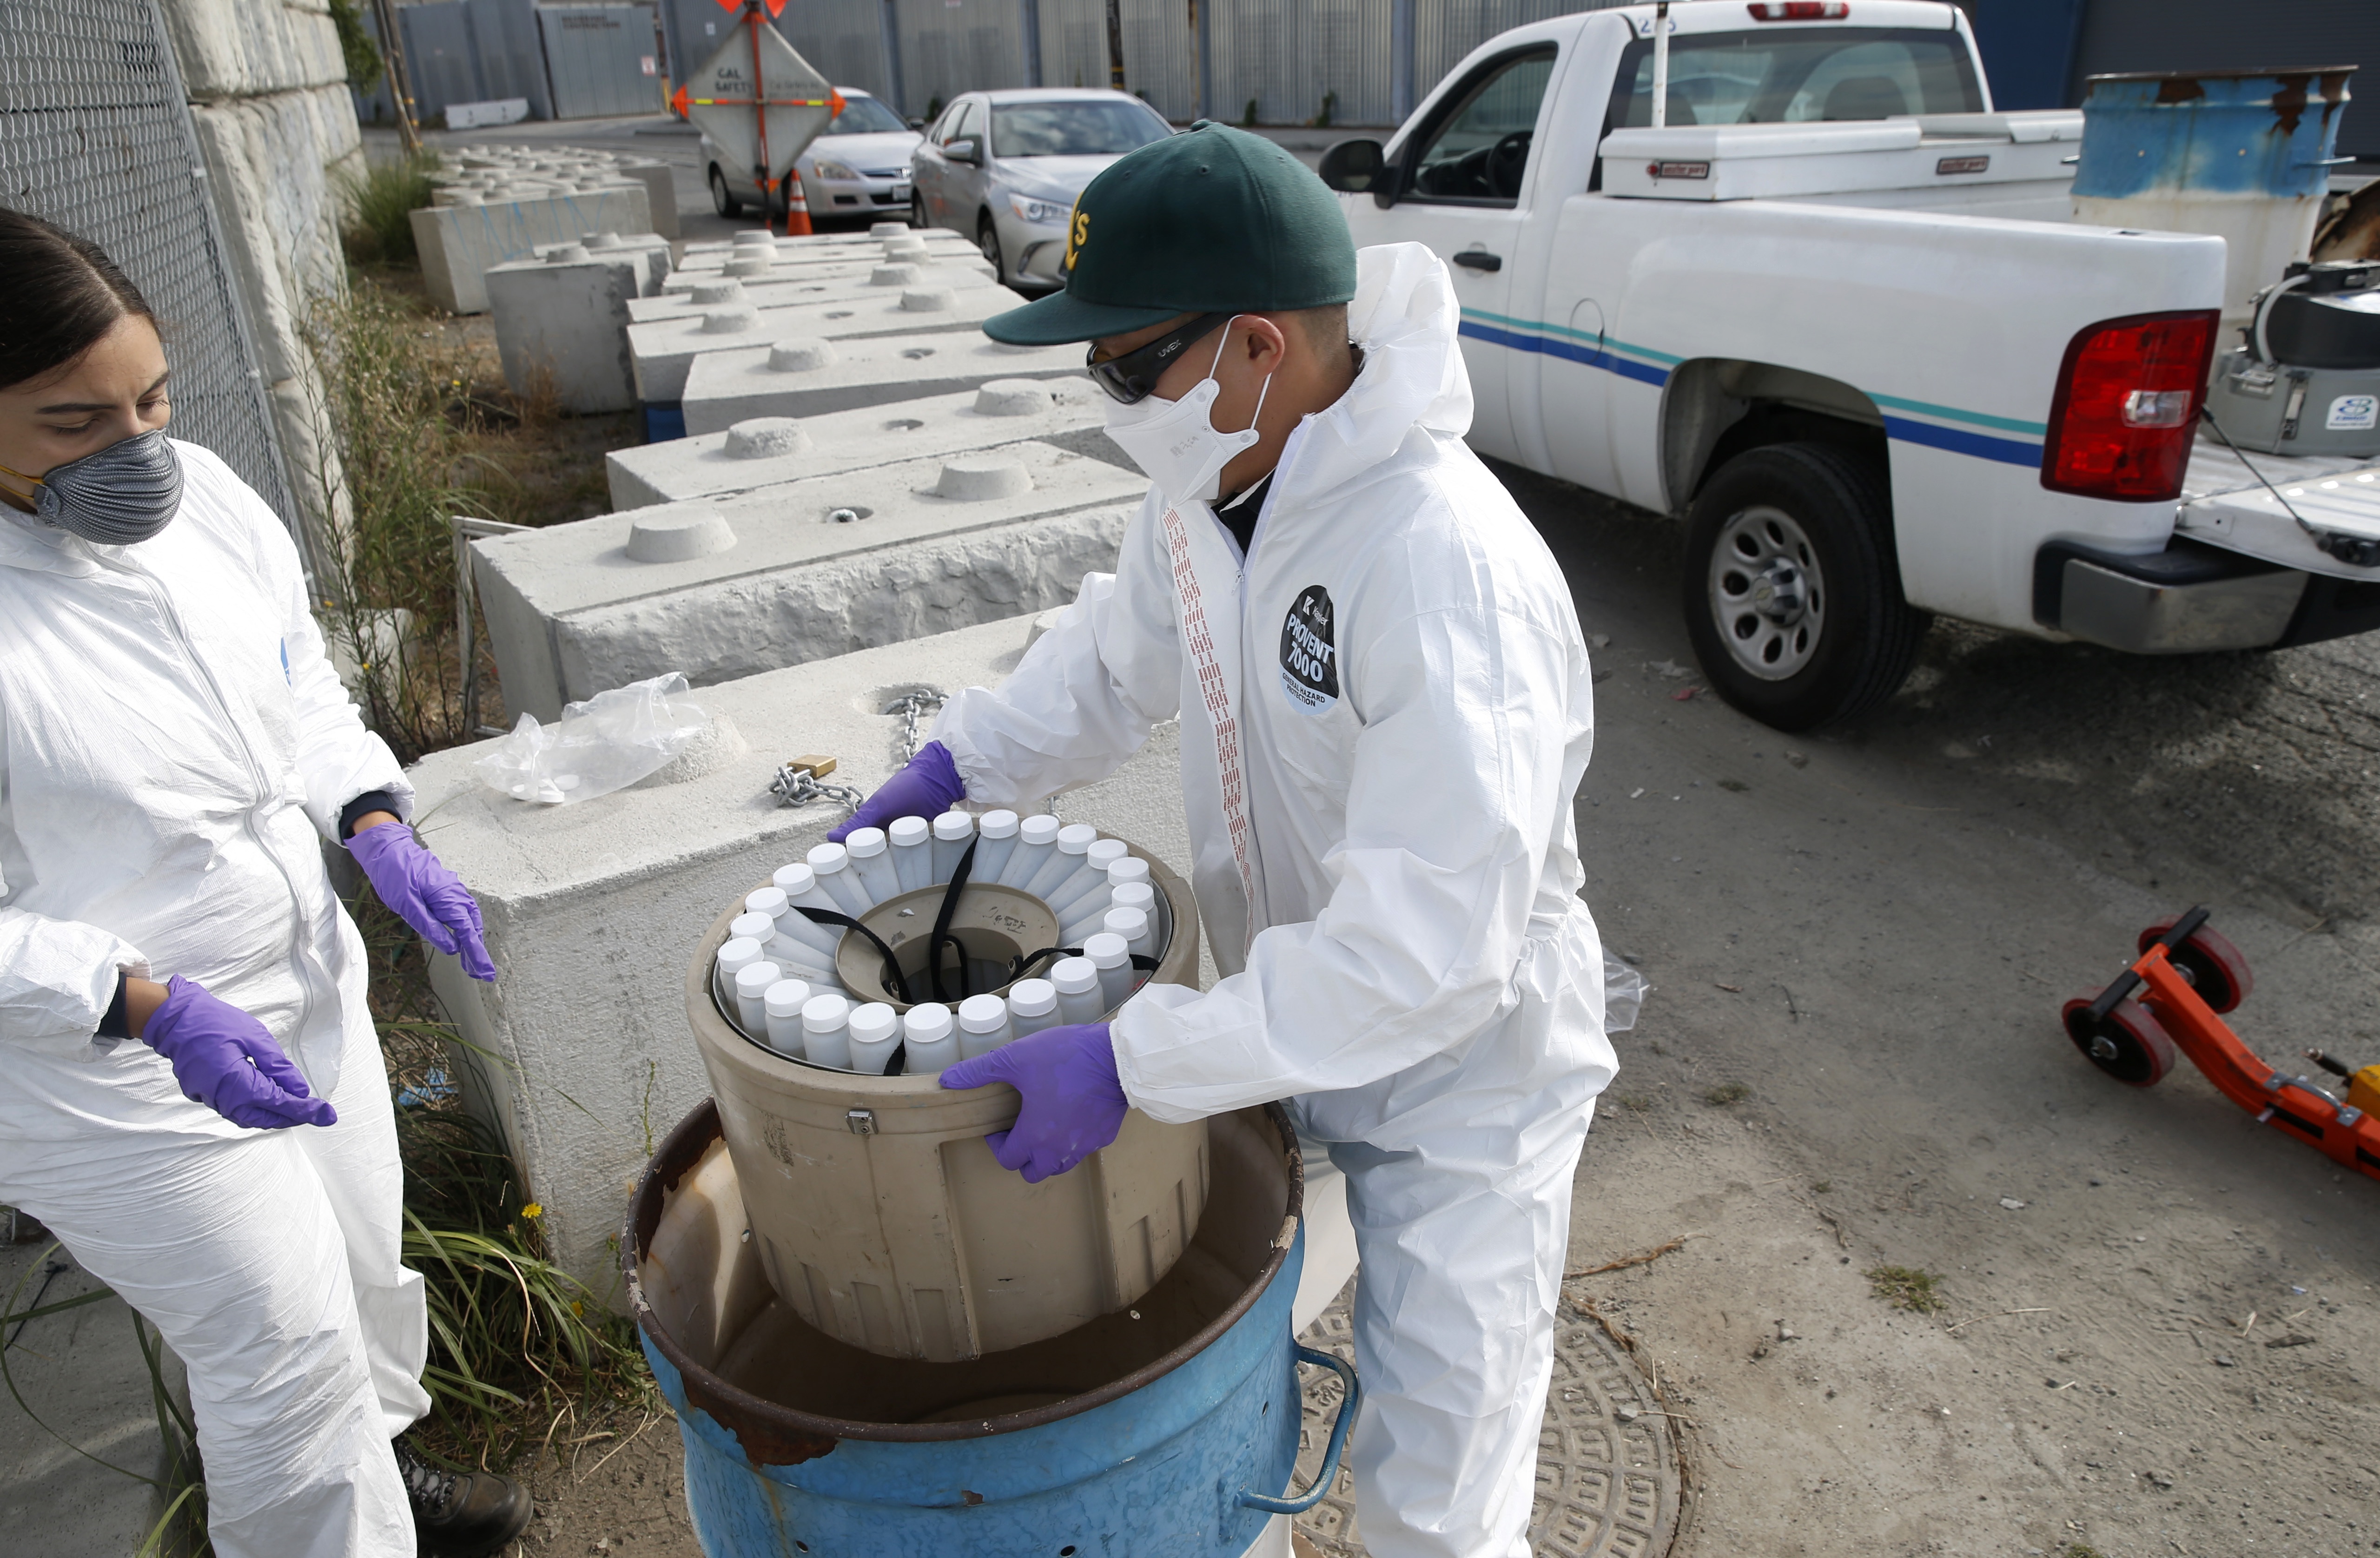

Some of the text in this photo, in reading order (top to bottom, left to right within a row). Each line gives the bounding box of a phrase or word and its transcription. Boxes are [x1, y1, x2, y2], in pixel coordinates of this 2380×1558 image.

[718, 68, 741, 79] CAL
[1286, 613, 1335, 664] PROVENT
[1287, 640, 1323, 682] 7000
[1283, 672, 1325, 703] GENERAL HAZARD
[1287, 684, 1316, 707] PROTECTION
